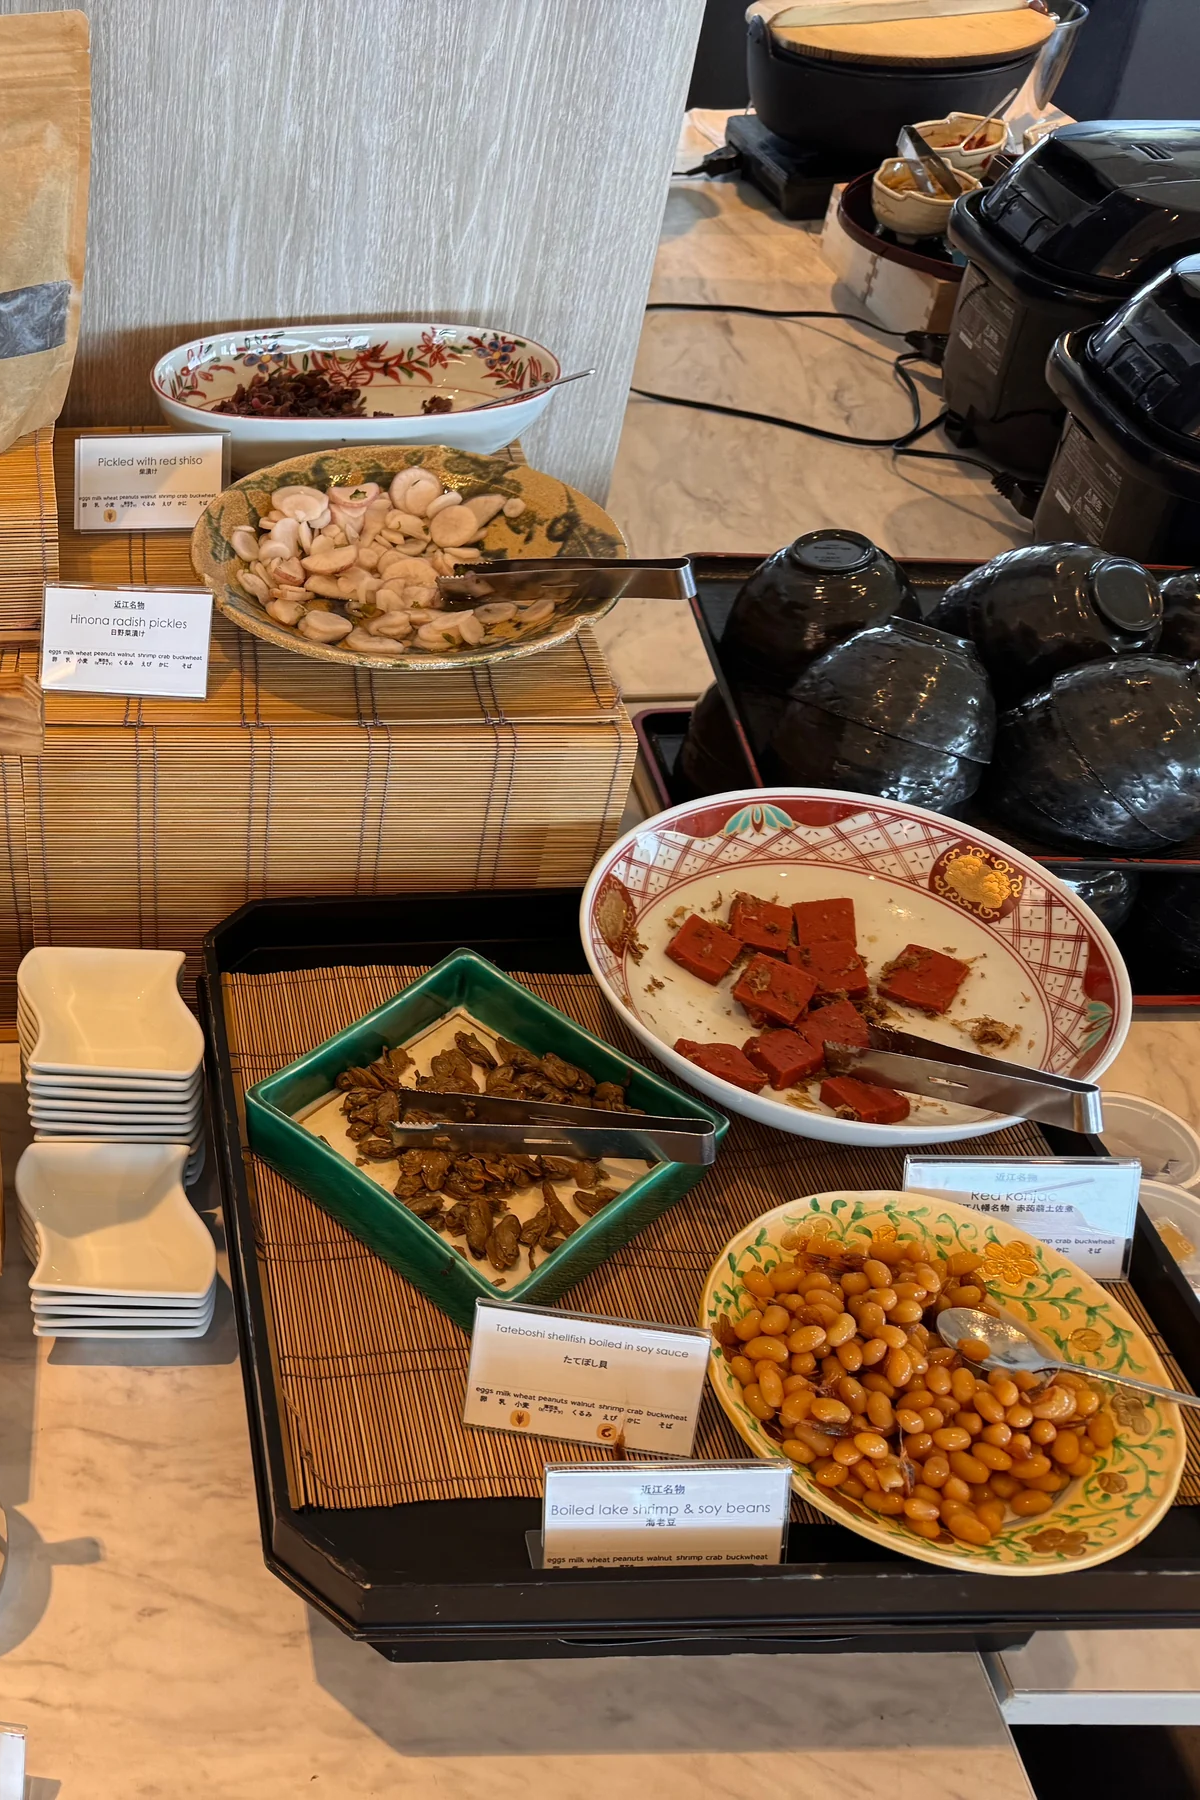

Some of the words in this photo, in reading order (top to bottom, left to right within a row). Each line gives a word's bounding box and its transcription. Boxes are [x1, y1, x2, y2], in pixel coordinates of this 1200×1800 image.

[98, 458, 134, 466] Pickled
[136, 457, 157, 466] with
[159, 457, 176, 465] red
[179, 456, 202, 465] shiso
[113, 601, 145, 609] 近江名物
[70, 614, 109, 625] Hinona
[112, 616, 146, 627] radish
[149, 618, 187, 629] pickles
[111, 629, 145, 637] 日野菜漬け
[496, 1324, 546, 1339] Tateboshi
[548, 1331, 586, 1345] shellfish
[589, 1337, 622, 1350] boiled
[624, 1341, 634, 1351] in
[636, 1344, 653, 1355] soy
[656, 1346, 689, 1359] sauce
[563, 1355, 608, 1369] たてぼし貝
[476, 1386, 493, 1395] eggs
[496, 1389, 511, 1397] milk
[513, 1392, 536, 1401] wheat
[538, 1395, 568, 1405] peanuts
[570, 1400, 595, 1408] walnut
[598, 1403, 625, 1413] shrimp
[627, 1407, 644, 1416] crab
[646, 1410, 688, 1422] buckwheat
[572, 1409, 593, 1417] くるみ
[603, 1413, 618, 1422] えび
[627, 1417, 641, 1425] かに
[659, 1422, 673, 1430] そば
[640, 1484, 686, 1495] 近江名物
[551, 1504, 594, 1516] Boiled
[599, 1503, 628, 1515] lake
[633, 1503, 679, 1517] shrimp
[684, 1503, 694, 1514] &
[698, 1503, 722, 1516] soy
[726, 1502, 771, 1513] beans
[645, 1518, 677, 1527] 海老豆
[676, 1554, 703, 1562] shrimp
